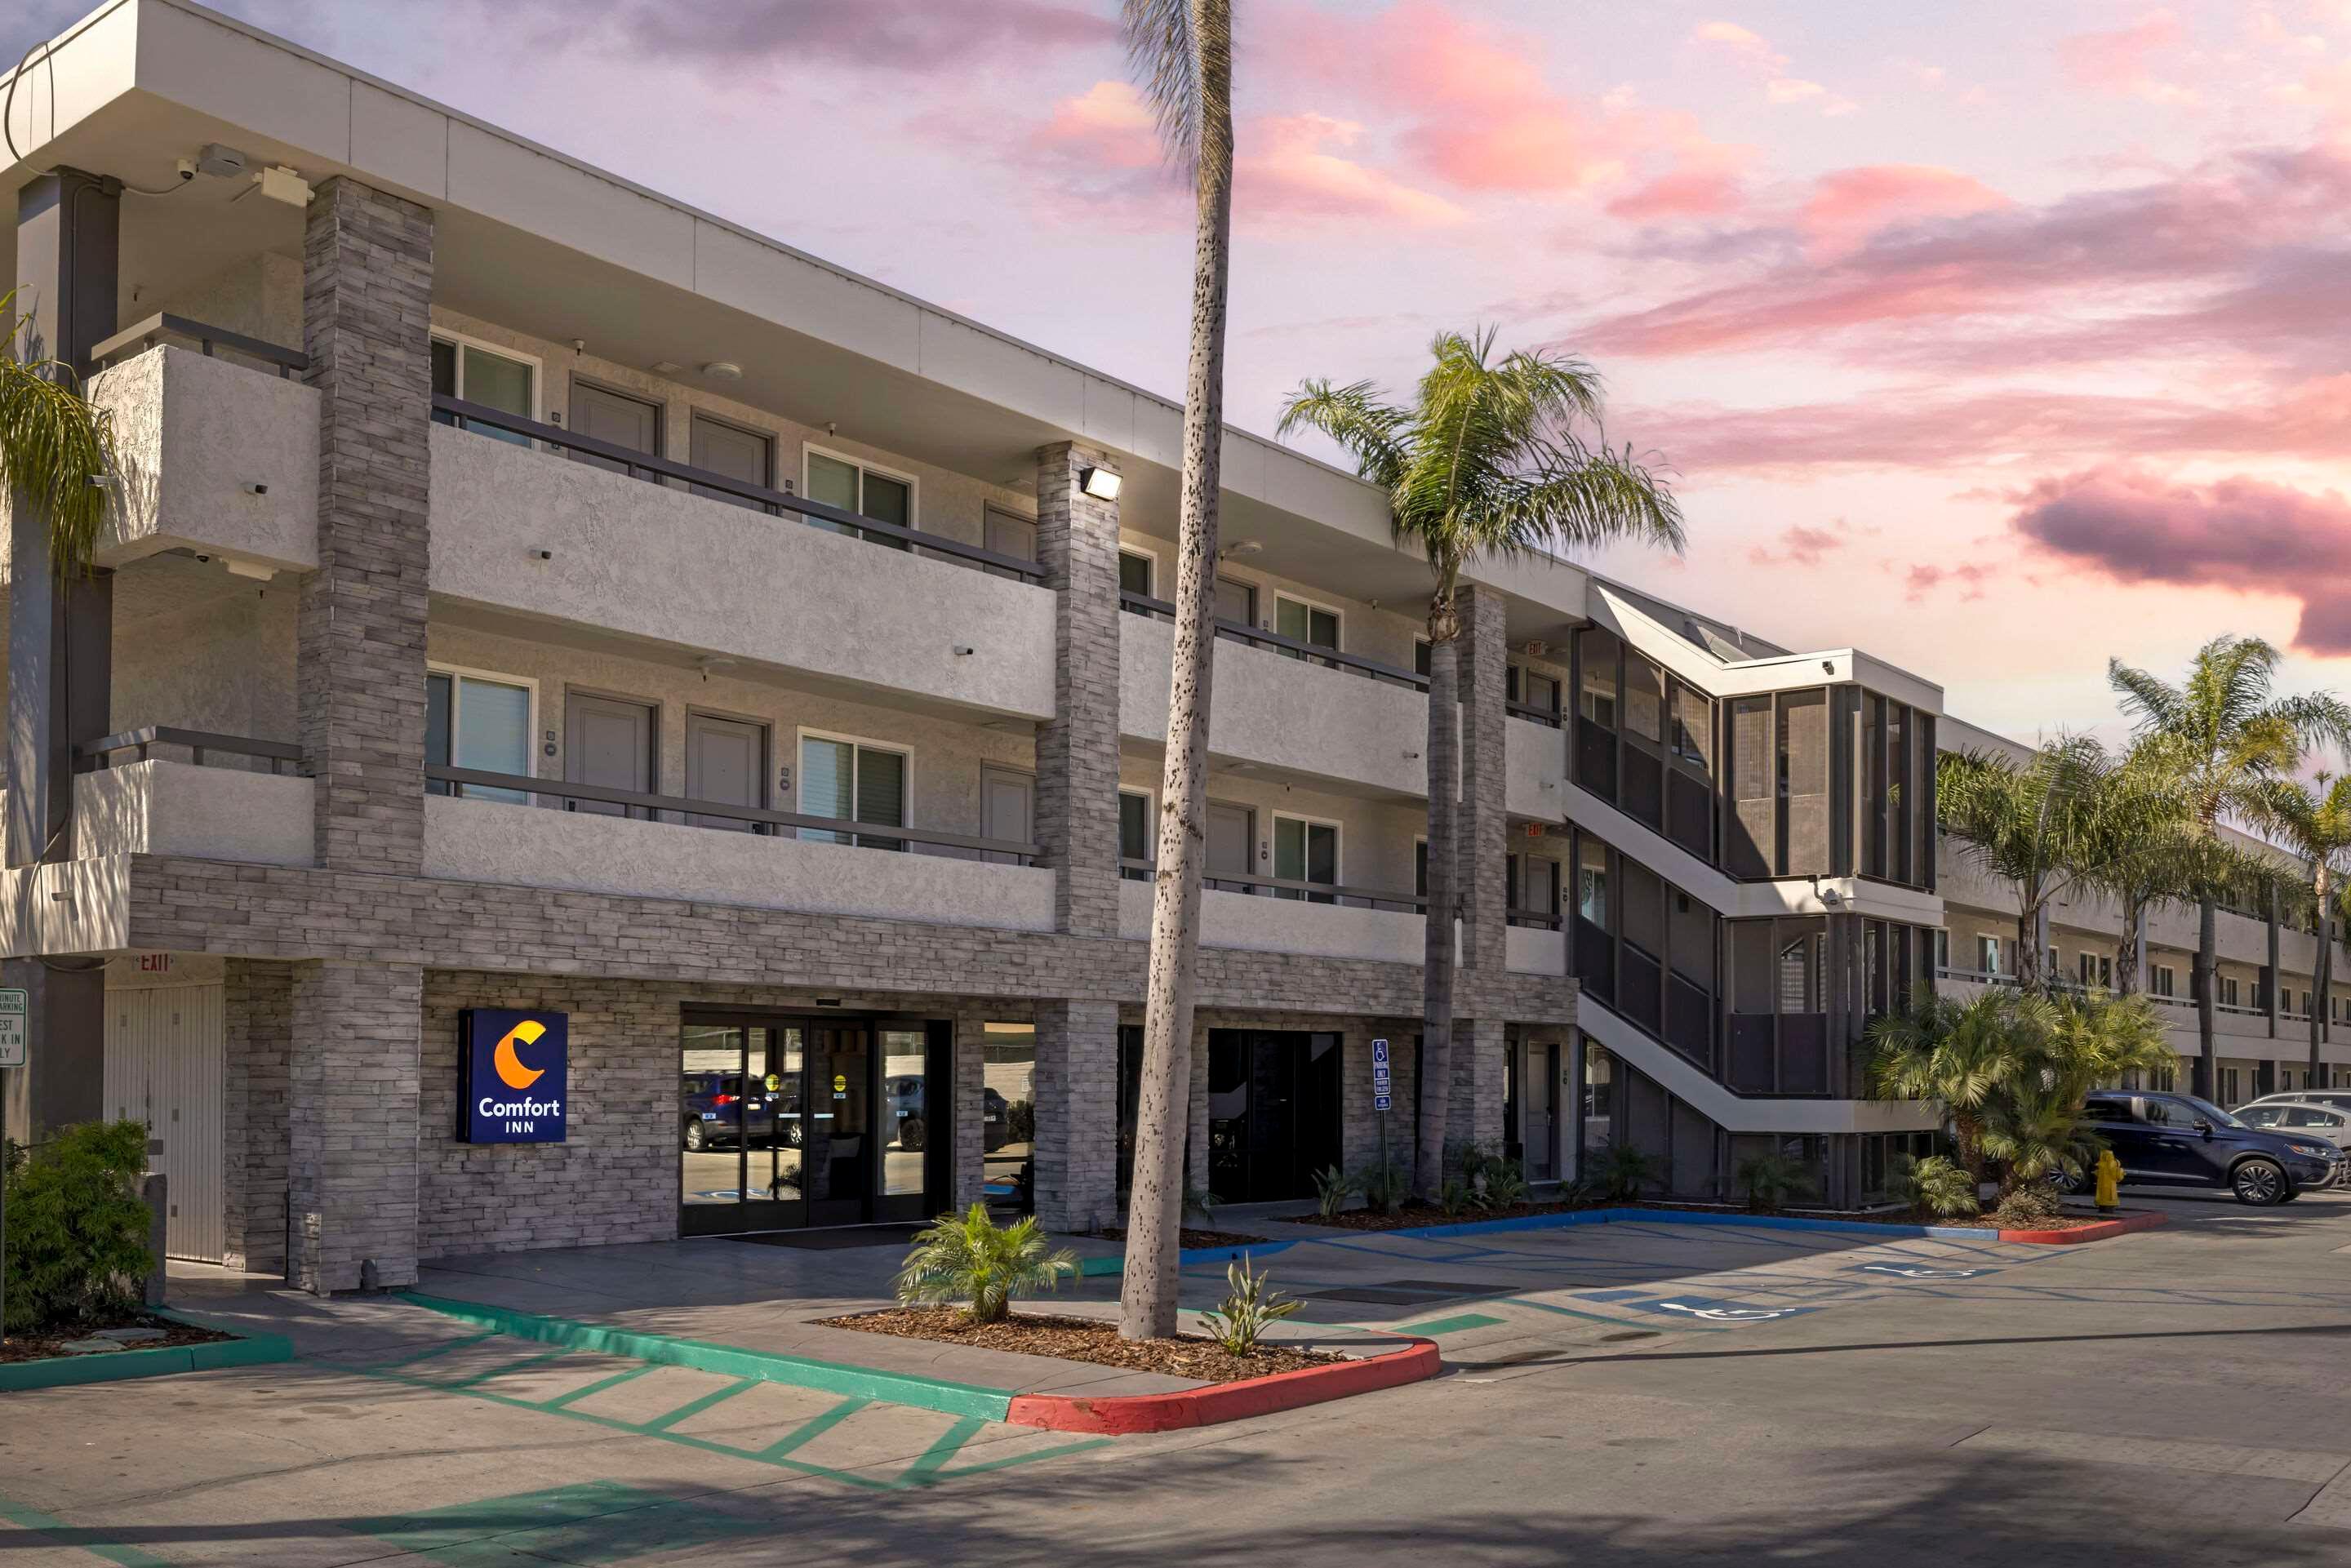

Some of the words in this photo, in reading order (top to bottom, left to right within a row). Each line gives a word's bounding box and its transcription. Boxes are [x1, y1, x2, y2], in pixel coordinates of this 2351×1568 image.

[141, 953, 168, 971] EXIT
[0, 994, 20, 1002] INUTE
[11, 1033, 20, 1045] IN
[479, 1097, 559, 1117] Comfort
[505, 1121, 534, 1133] INN
